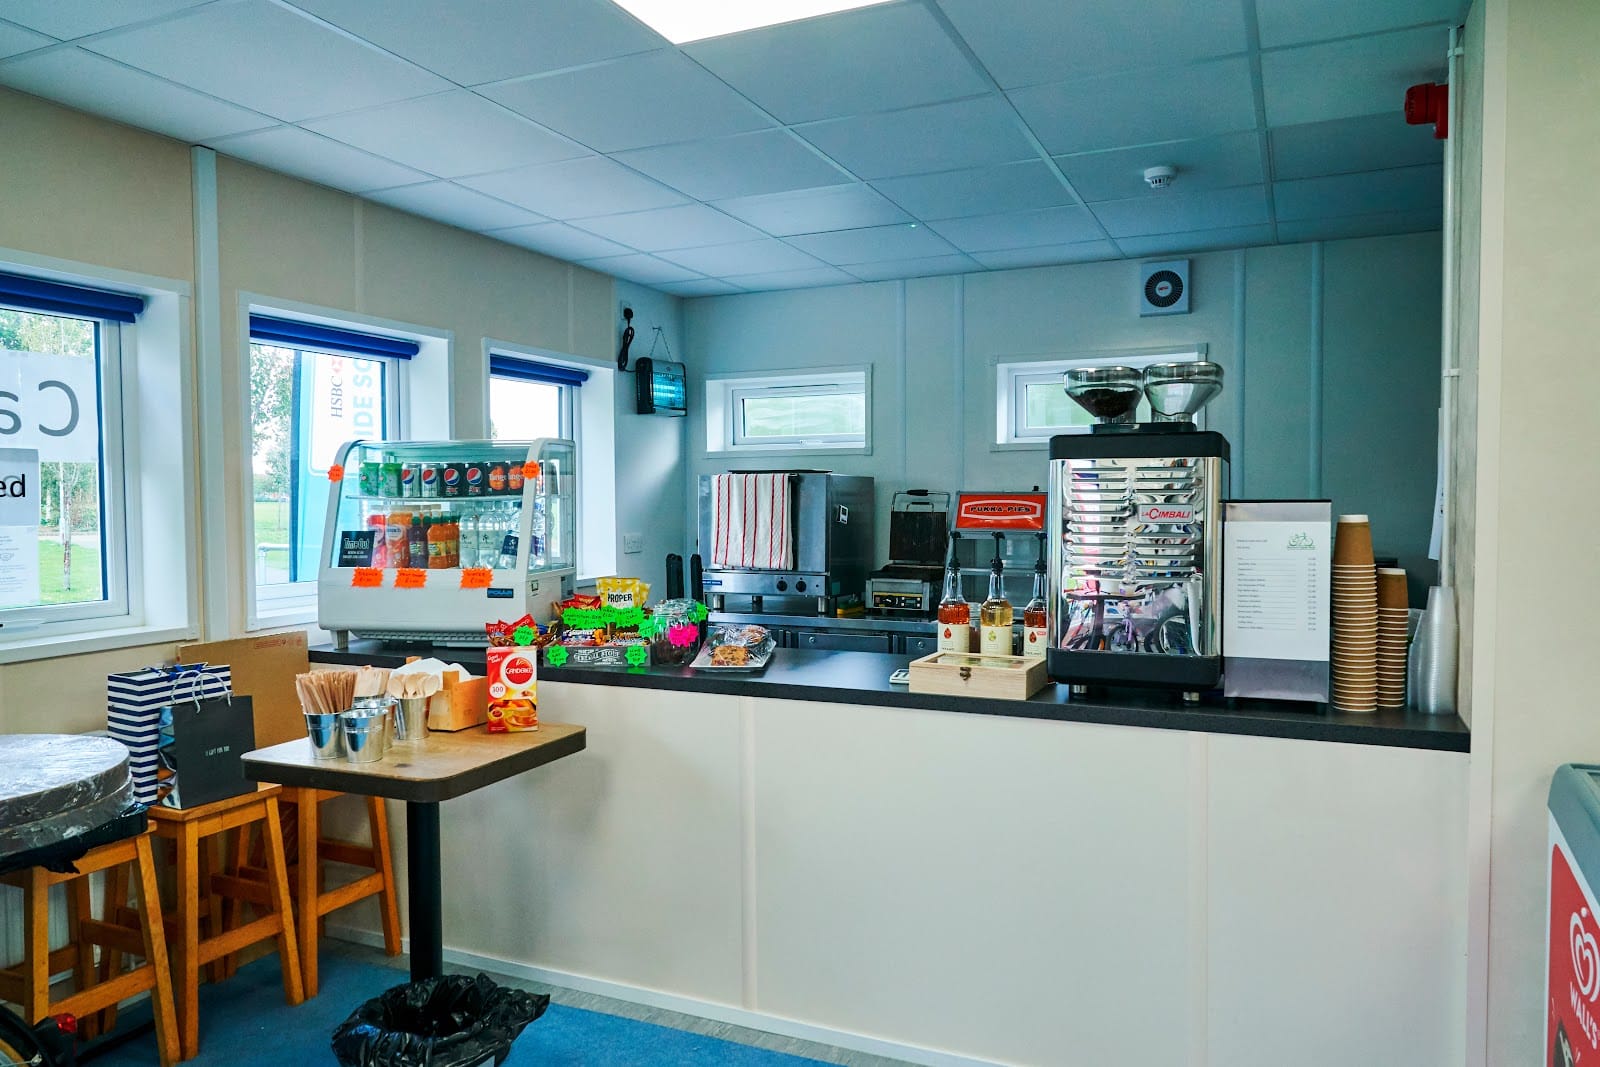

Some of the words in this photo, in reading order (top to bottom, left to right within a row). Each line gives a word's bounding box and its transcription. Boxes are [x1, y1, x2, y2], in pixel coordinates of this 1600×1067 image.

[330, 375, 343, 418] HSBC
[607, 593, 633, 603] PROPER
[1569, 981, 1598, 1050] WALL'S
